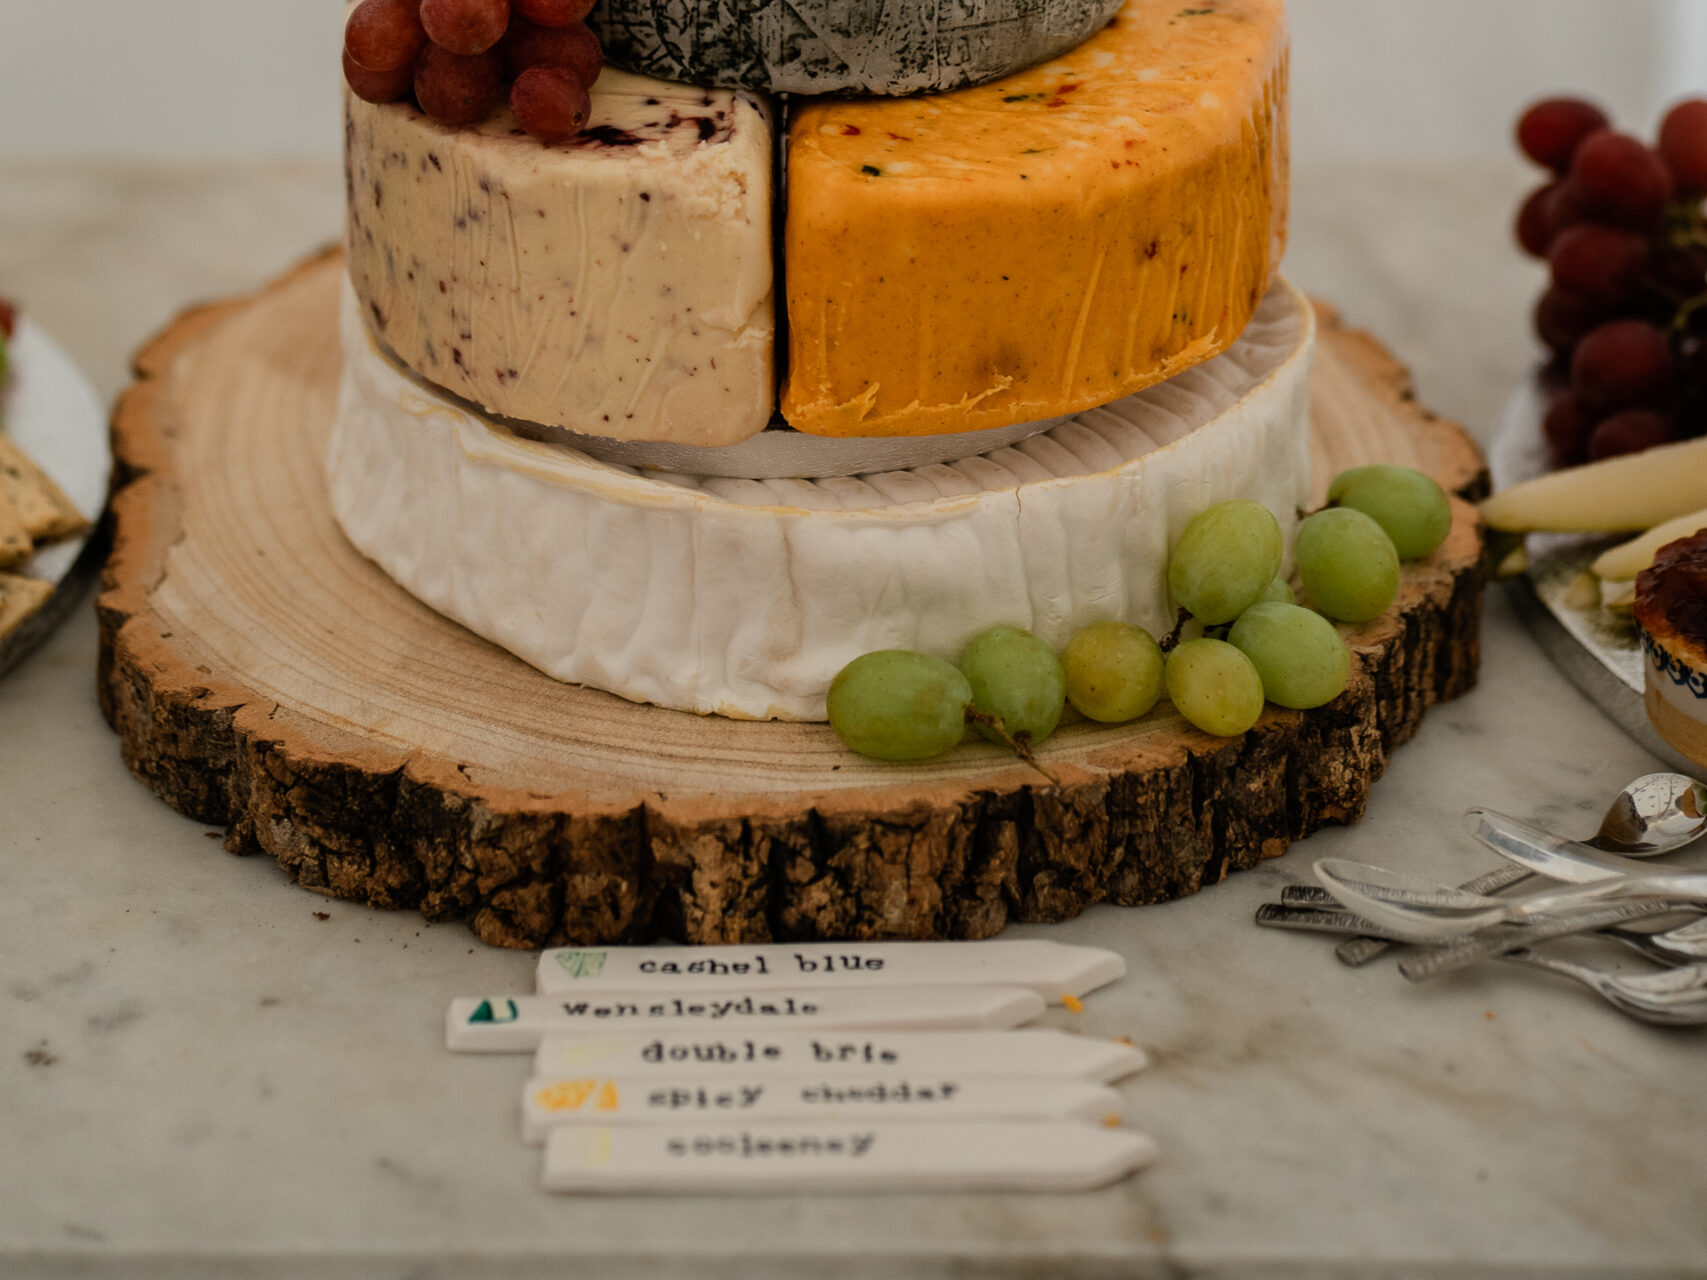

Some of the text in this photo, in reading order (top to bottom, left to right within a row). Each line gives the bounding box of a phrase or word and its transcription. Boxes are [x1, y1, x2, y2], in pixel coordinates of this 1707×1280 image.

[639, 953, 885, 975] cashel blue
[641, 1040, 898, 1063] double brie
[801, 1081, 958, 1103] cheddar
